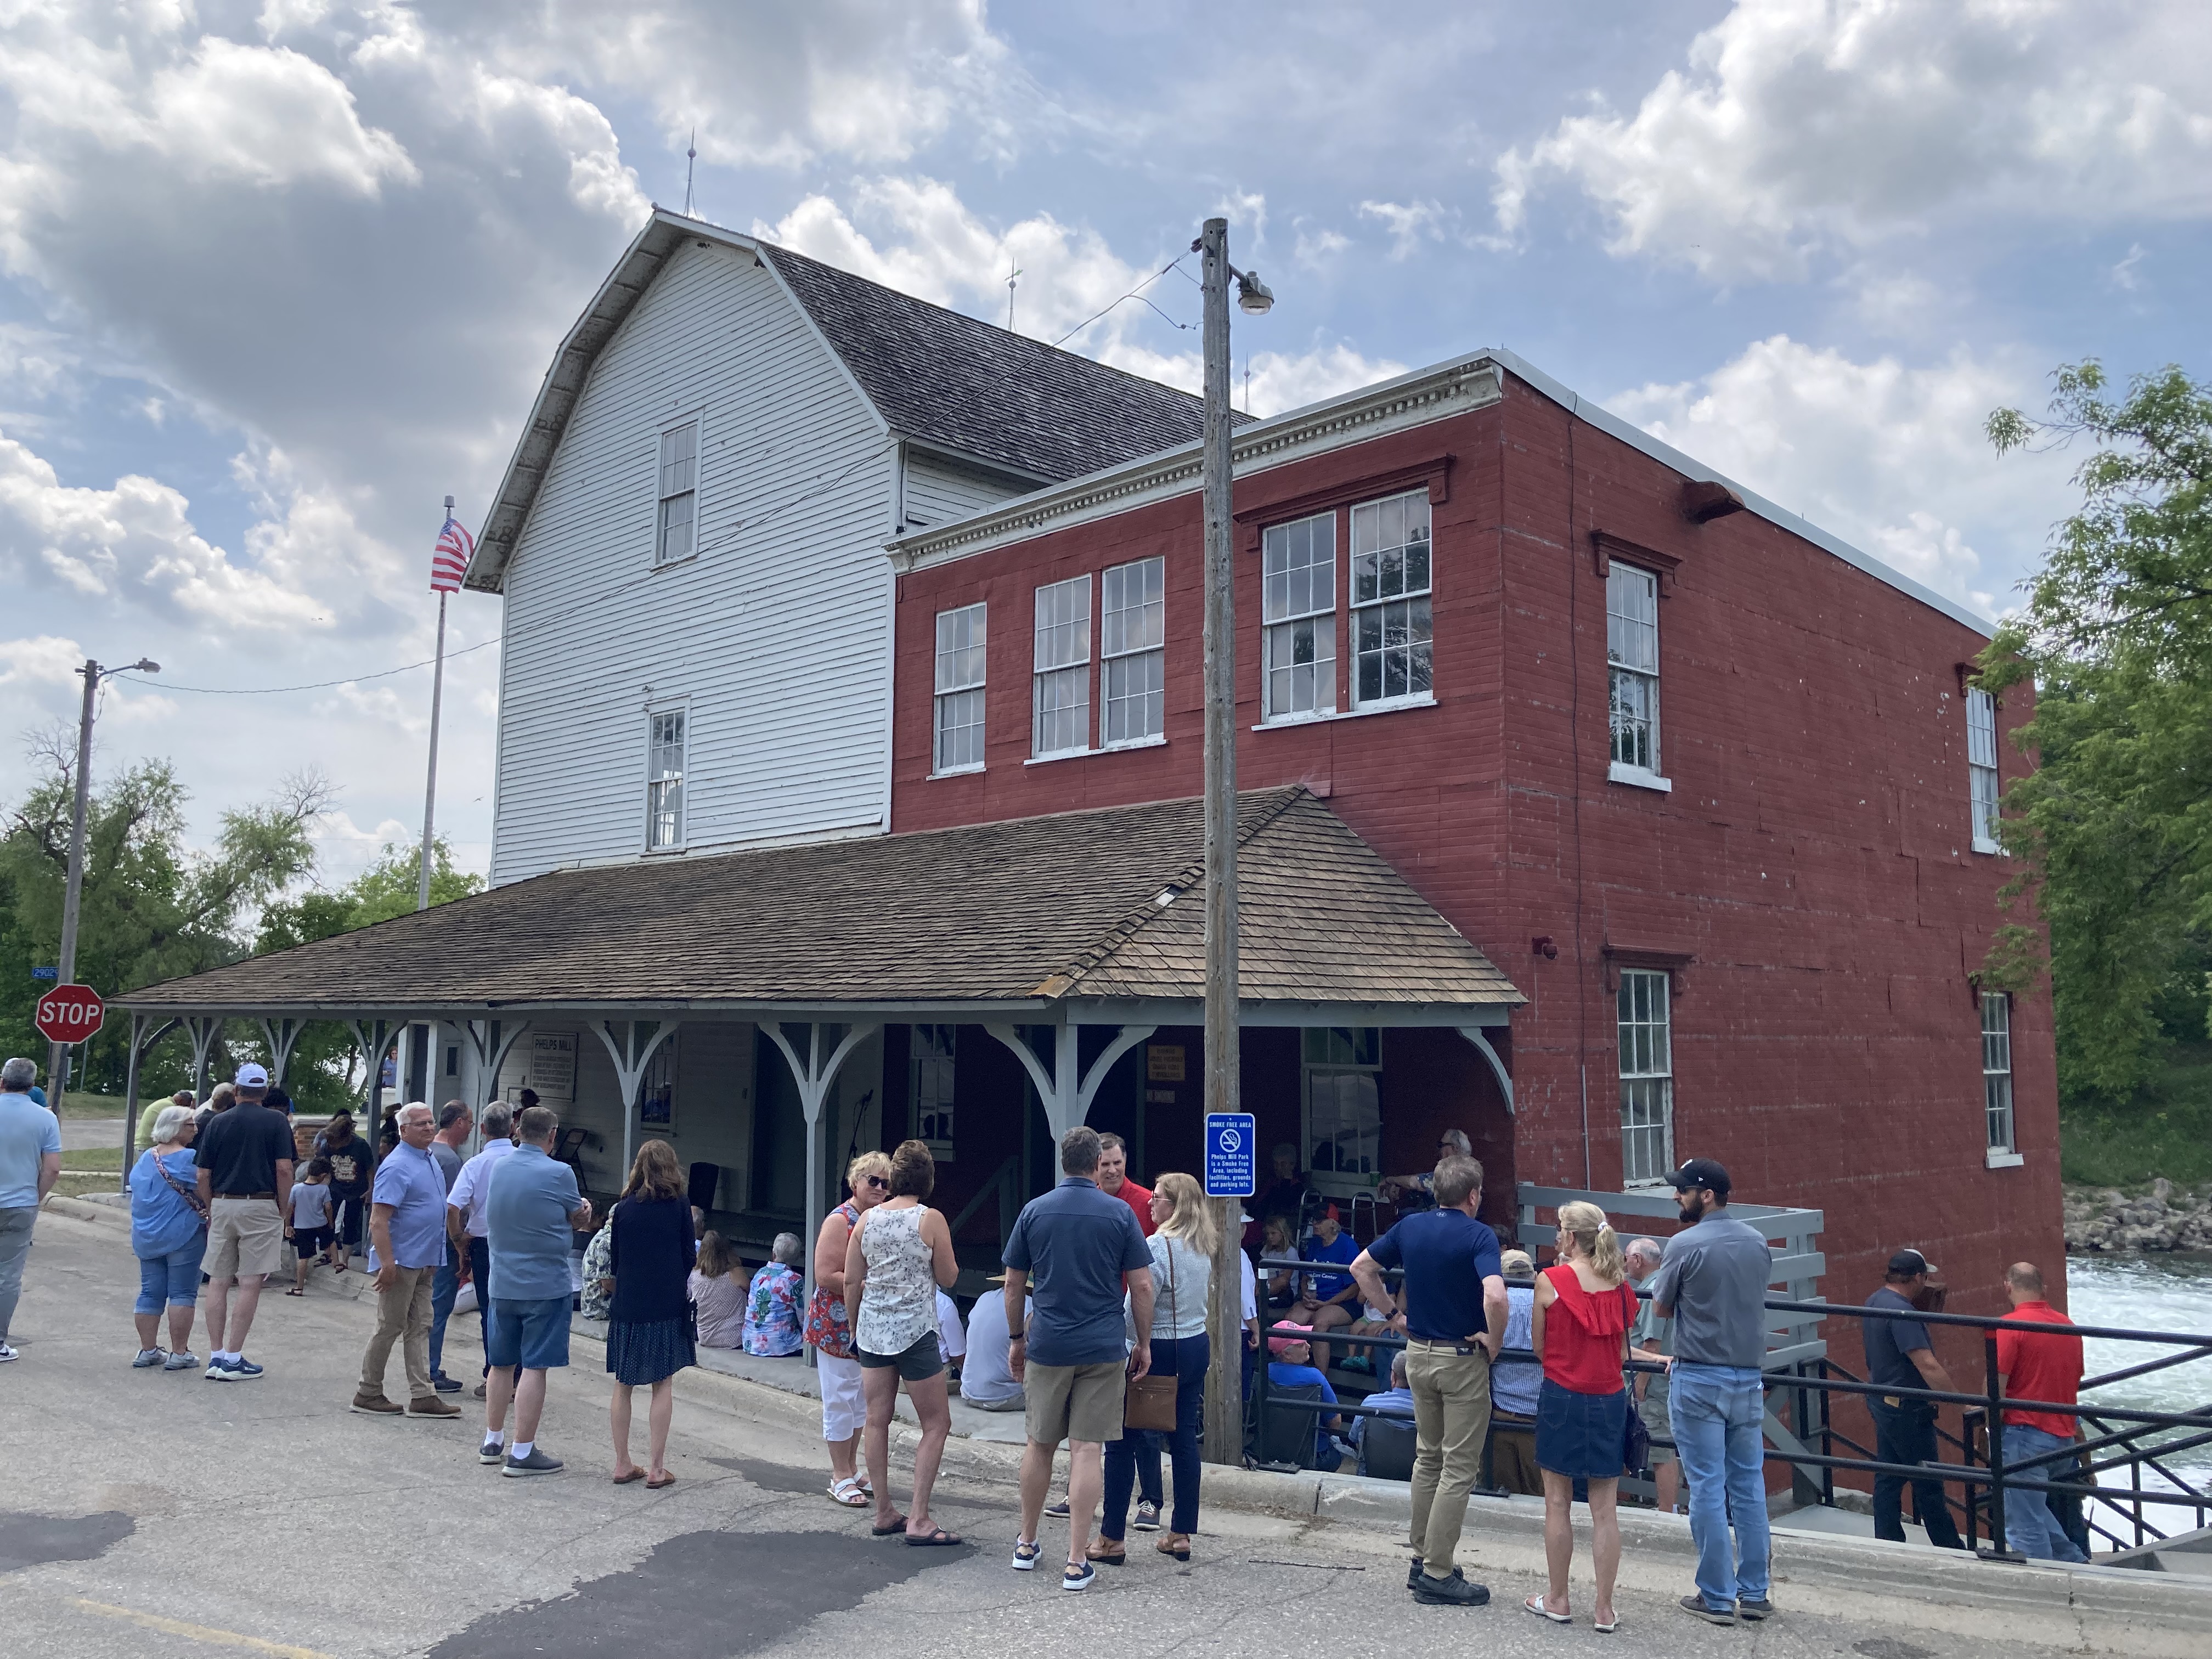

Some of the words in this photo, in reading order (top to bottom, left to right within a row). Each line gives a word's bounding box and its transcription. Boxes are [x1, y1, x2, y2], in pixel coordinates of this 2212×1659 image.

[41, 1001, 100, 1025] STOP
[535, 1039, 557, 1050] PHELPS
[558, 1040, 572, 1051] MILL
